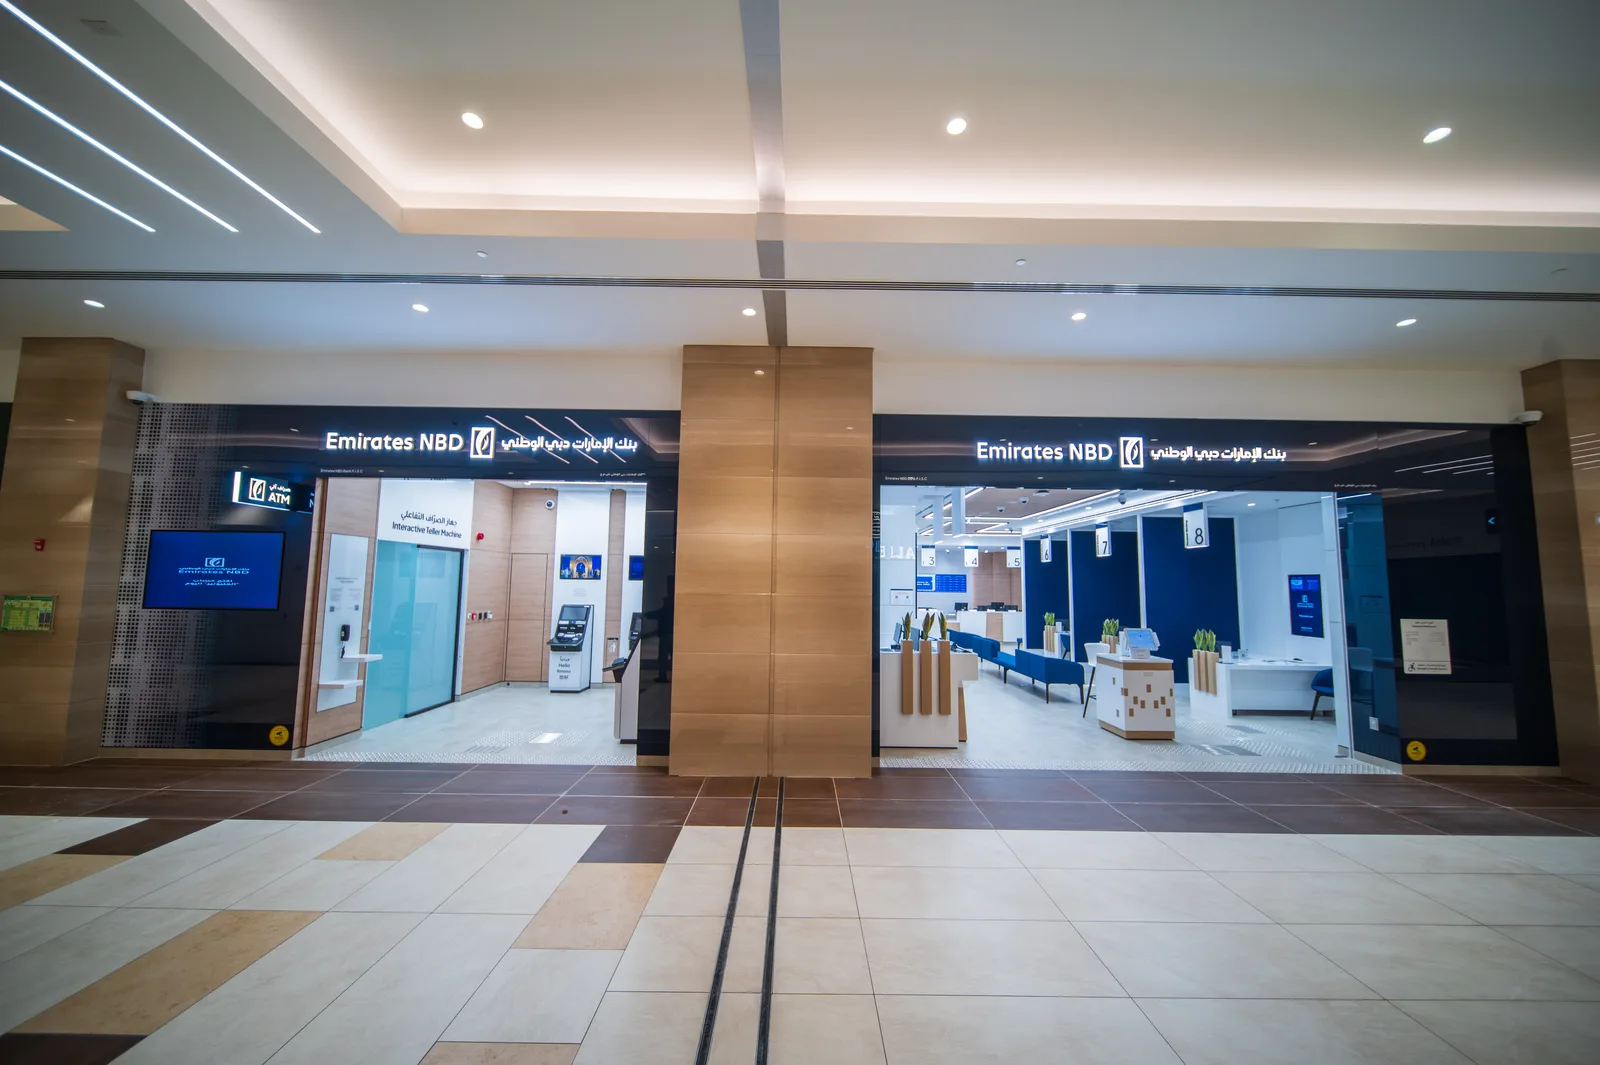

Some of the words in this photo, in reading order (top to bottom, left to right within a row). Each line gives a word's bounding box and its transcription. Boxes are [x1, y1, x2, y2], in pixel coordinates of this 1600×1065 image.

[326, 432, 414, 450] Emirates
[420, 433, 464, 451] NBD
[501, 436, 544, 451] الوطني
[545, 439, 570, 450] دبي
[572, 437, 613, 452] الإمارات
[614, 438, 638, 452] بنك
[976, 442, 1063, 460] Emirates
[1069, 442, 1113, 461] NBD
[1150, 446, 1193, 461] الوطني
[1194, 450, 1220, 461] دبي
[1220, 446, 1262, 462] الإمارات
[1264, 448, 1286, 462] بنك
[268, 492, 290, 505] ATM
[400, 510, 424, 520] التفاعلي
[392, 521, 425, 533] Interactive
[426, 526, 440, 536] Teller
[441, 529, 462, 538] Machine
[1194, 527, 1204, 545] 8
[1102, 541, 1107, 554] 7
[929, 557, 935, 565] 3
[971, 557, 977, 565] 4
[1014, 558, 1020, 566] 5
[1044, 550, 1049, 560] 6
